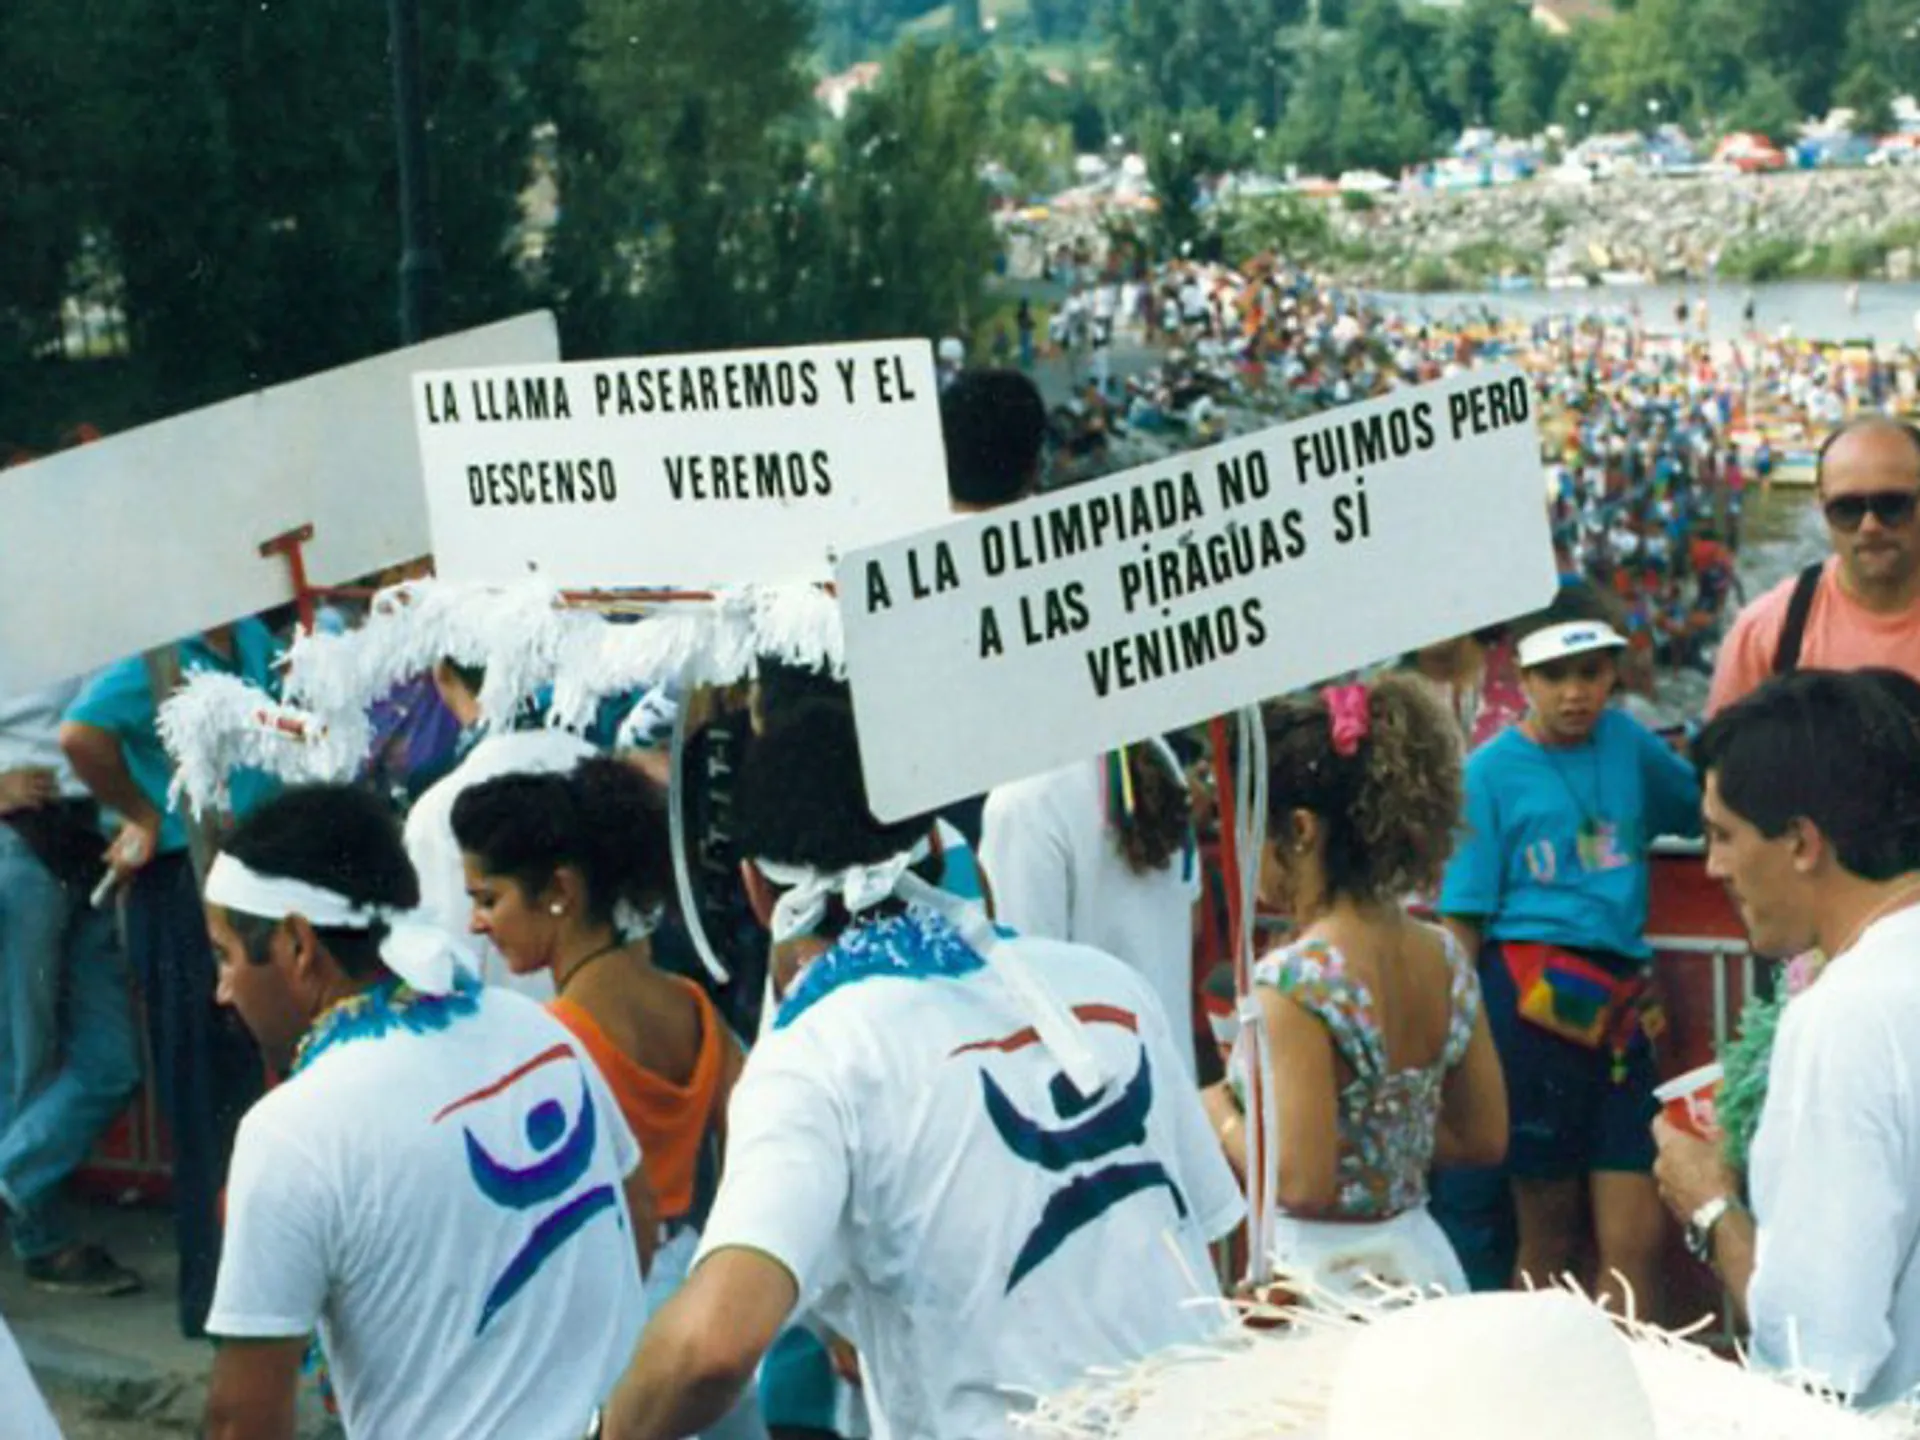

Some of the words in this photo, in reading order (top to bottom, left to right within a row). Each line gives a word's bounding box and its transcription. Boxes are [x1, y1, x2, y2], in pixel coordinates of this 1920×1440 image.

[425, 382, 460, 423] LA
[472, 377, 570, 421] LLAMA
[595, 360, 818, 415] PASEAREMOS
[836, 359, 855, 404] Y
[874, 356, 916, 403] EL
[467, 457, 617, 506] DESCENSO
[664, 450, 832, 500] VEREMOS
[866, 560, 892, 614] A
[907, 540, 960, 600] LA
[981, 471, 1204, 577] OLIMPIADA
[1216, 449, 1270, 510] NO
[1293, 401, 1435, 485] FUIMOS
[1448, 376, 1529, 440] PERO
[980, 606, 1004, 659] A
[1019, 581, 1090, 646] LAS
[1086, 597, 1267, 698] VENIMOS
